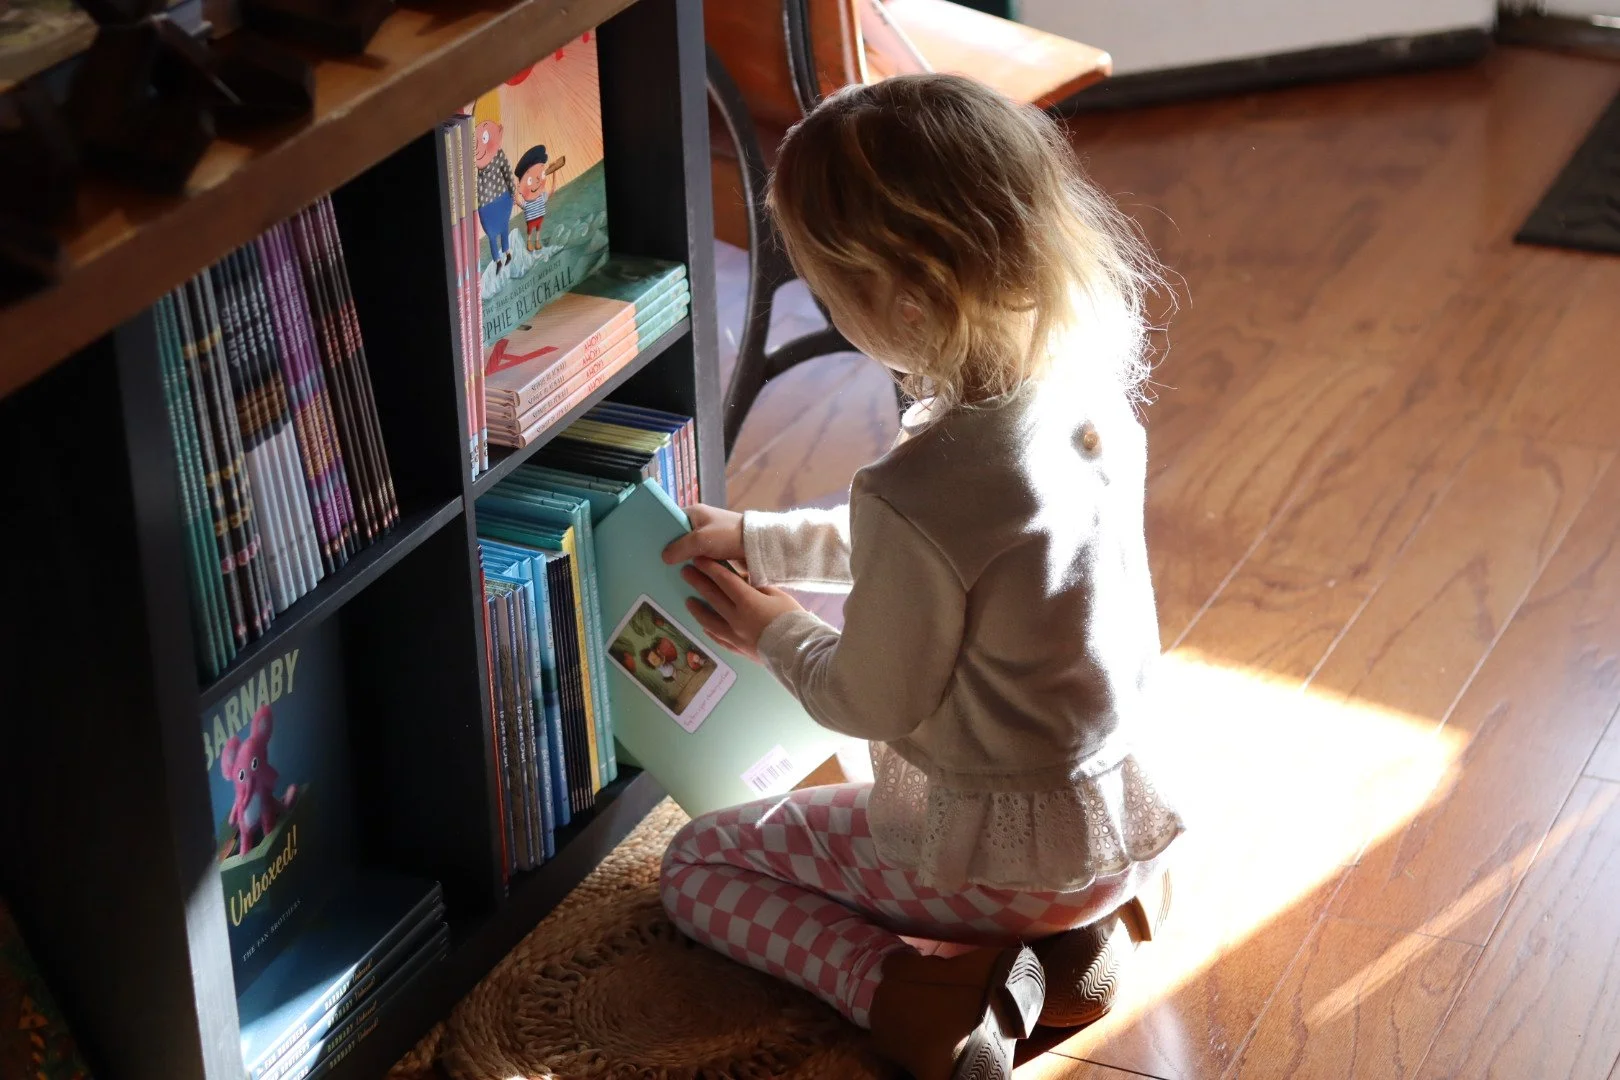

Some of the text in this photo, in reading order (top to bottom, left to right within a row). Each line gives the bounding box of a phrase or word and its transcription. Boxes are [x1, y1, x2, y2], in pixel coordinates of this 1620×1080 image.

[248, 290, 260, 317] CAT
[256, 281, 267, 308] CAT
[482, 265, 574, 342] OPHIE BLACKALL
[220, 306, 234, 334] CAT
[228, 301, 241, 327] CAT
[238, 295, 250, 322] CAT
[501, 736, 507, 746] an
[518, 731, 524, 741] an
[518, 743, 527, 763] Owl
[230, 824, 298, 927] Unboxed!
[240, 897, 304, 961] THE FAN BROTHERS
[325, 979, 350, 1011] BARNABY
[327, 1025, 354, 1051] BARNABY
